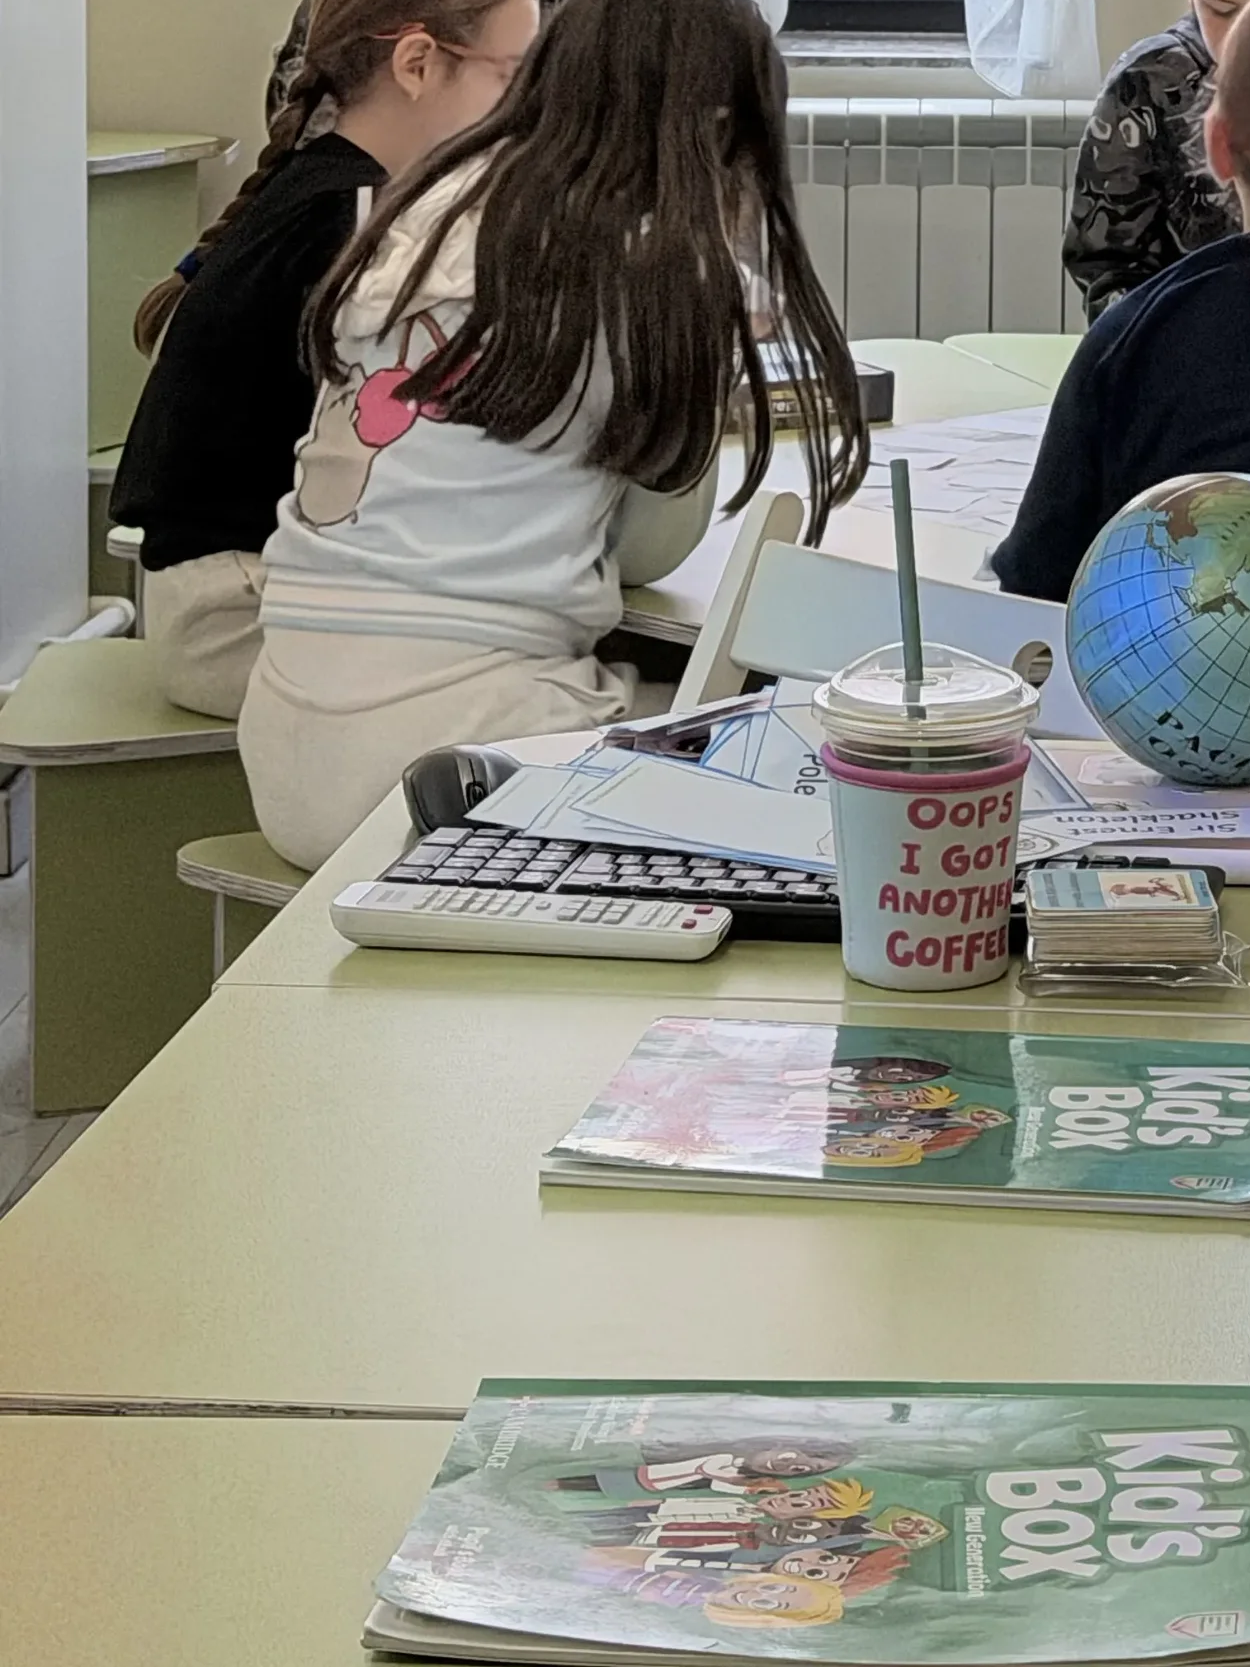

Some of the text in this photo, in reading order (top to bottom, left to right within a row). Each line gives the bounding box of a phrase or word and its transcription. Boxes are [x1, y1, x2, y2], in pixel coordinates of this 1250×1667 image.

[792, 752, 829, 797] Pole
[906, 790, 1015, 831] OOPS
[1053, 809, 1241, 824] Shackleton
[1065, 822, 1238, 837] Sir Ernest
[899, 835, 1012, 878] I GOT
[885, 929, 1007, 974] COFFEE
[485, 1407, 529, 1471] CAMBRIDGE
[1099, 1428, 1246, 1564] Kid's
[963, 1506, 990, 1599] New Generation
